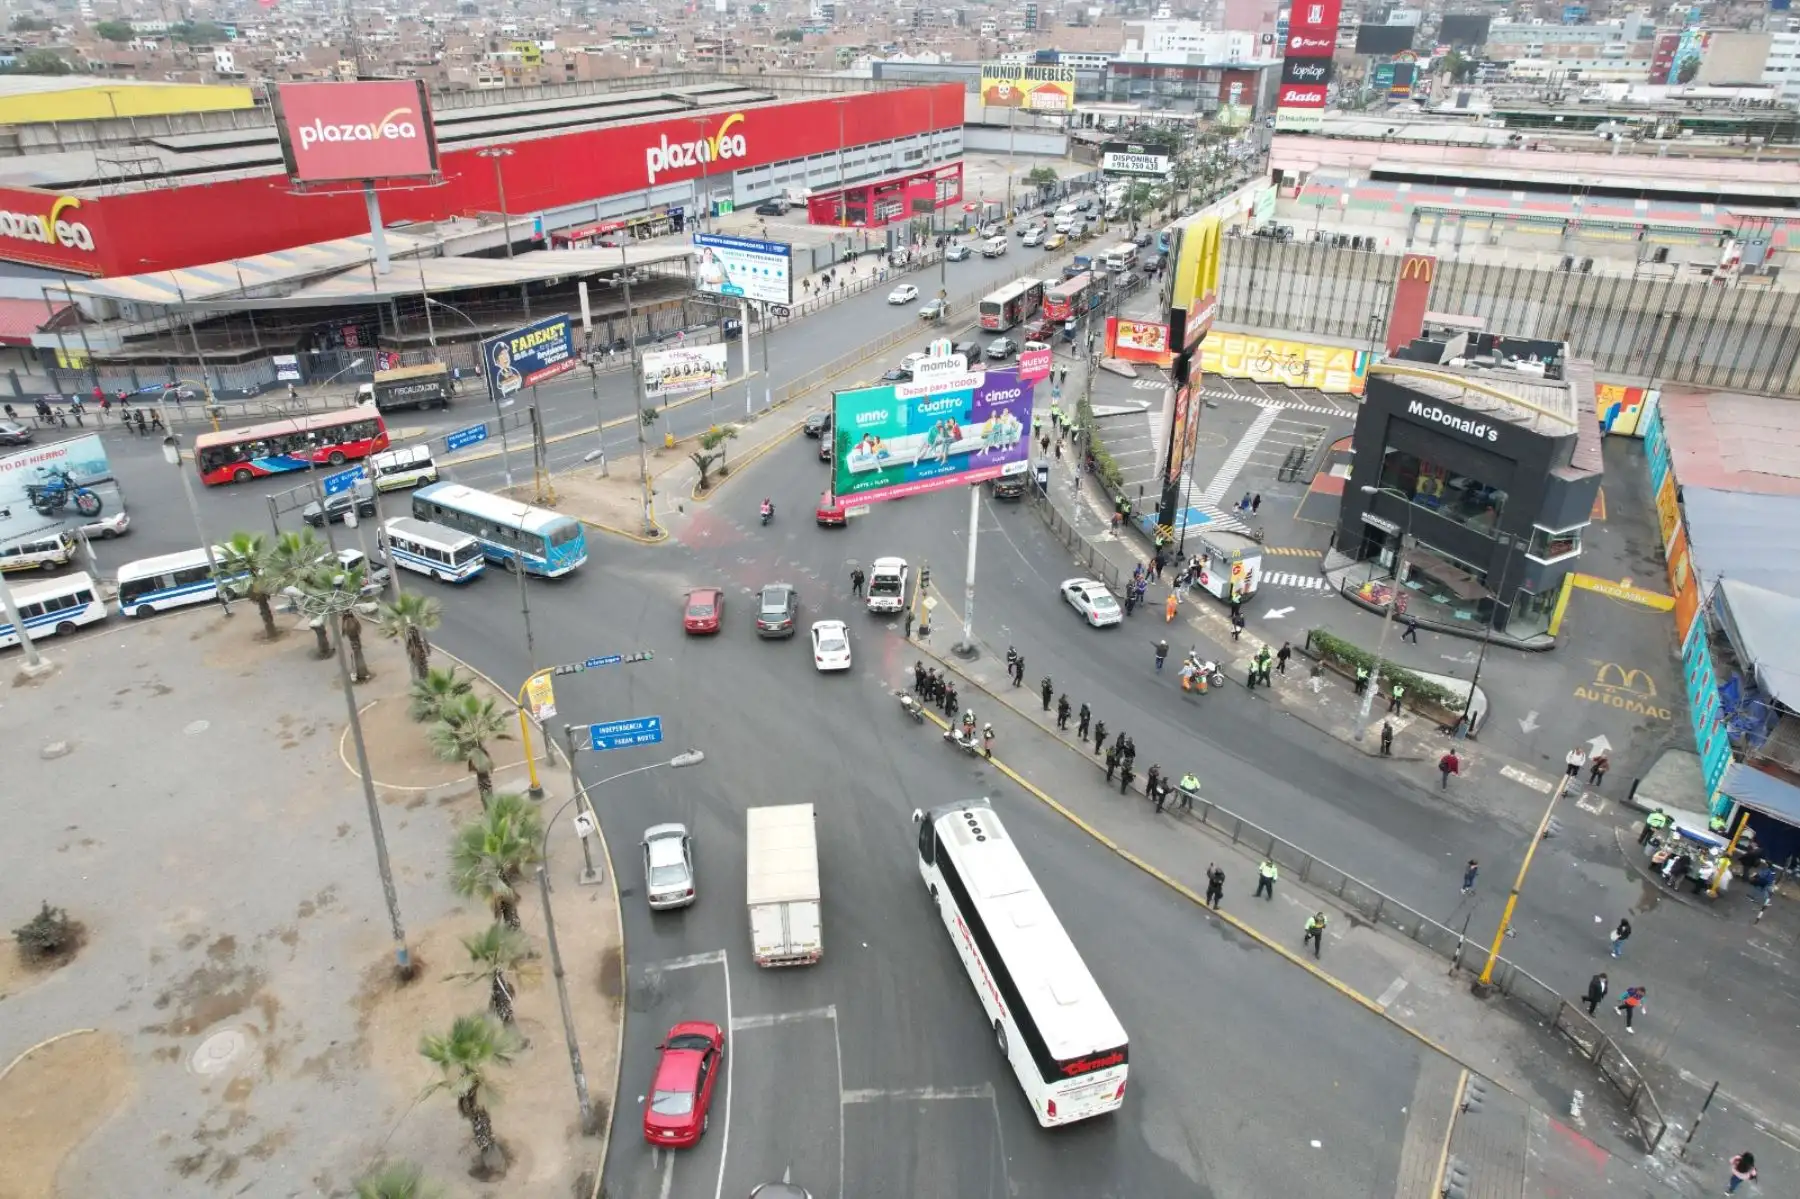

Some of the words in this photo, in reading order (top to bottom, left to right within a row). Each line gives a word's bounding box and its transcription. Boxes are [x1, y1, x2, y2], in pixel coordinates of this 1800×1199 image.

[983, 65, 1021, 80] MUNDO
[1024, 67, 1074, 82] MUEBLES
[1283, 90, 1322, 102] Bata
[1113, 154, 1159, 164] DISPONIBLE
[1022, 356, 1049, 368] NUEVO
[950, 378, 978, 389] TODOS
[985, 388, 1021, 403] cinnco
[856, 409, 888, 424] unno
[1408, 400, 1498, 442] McDonald's
[1573, 686, 1672, 720] AUTOMAC
[599, 723, 643, 734] INDEPENDENCIA
